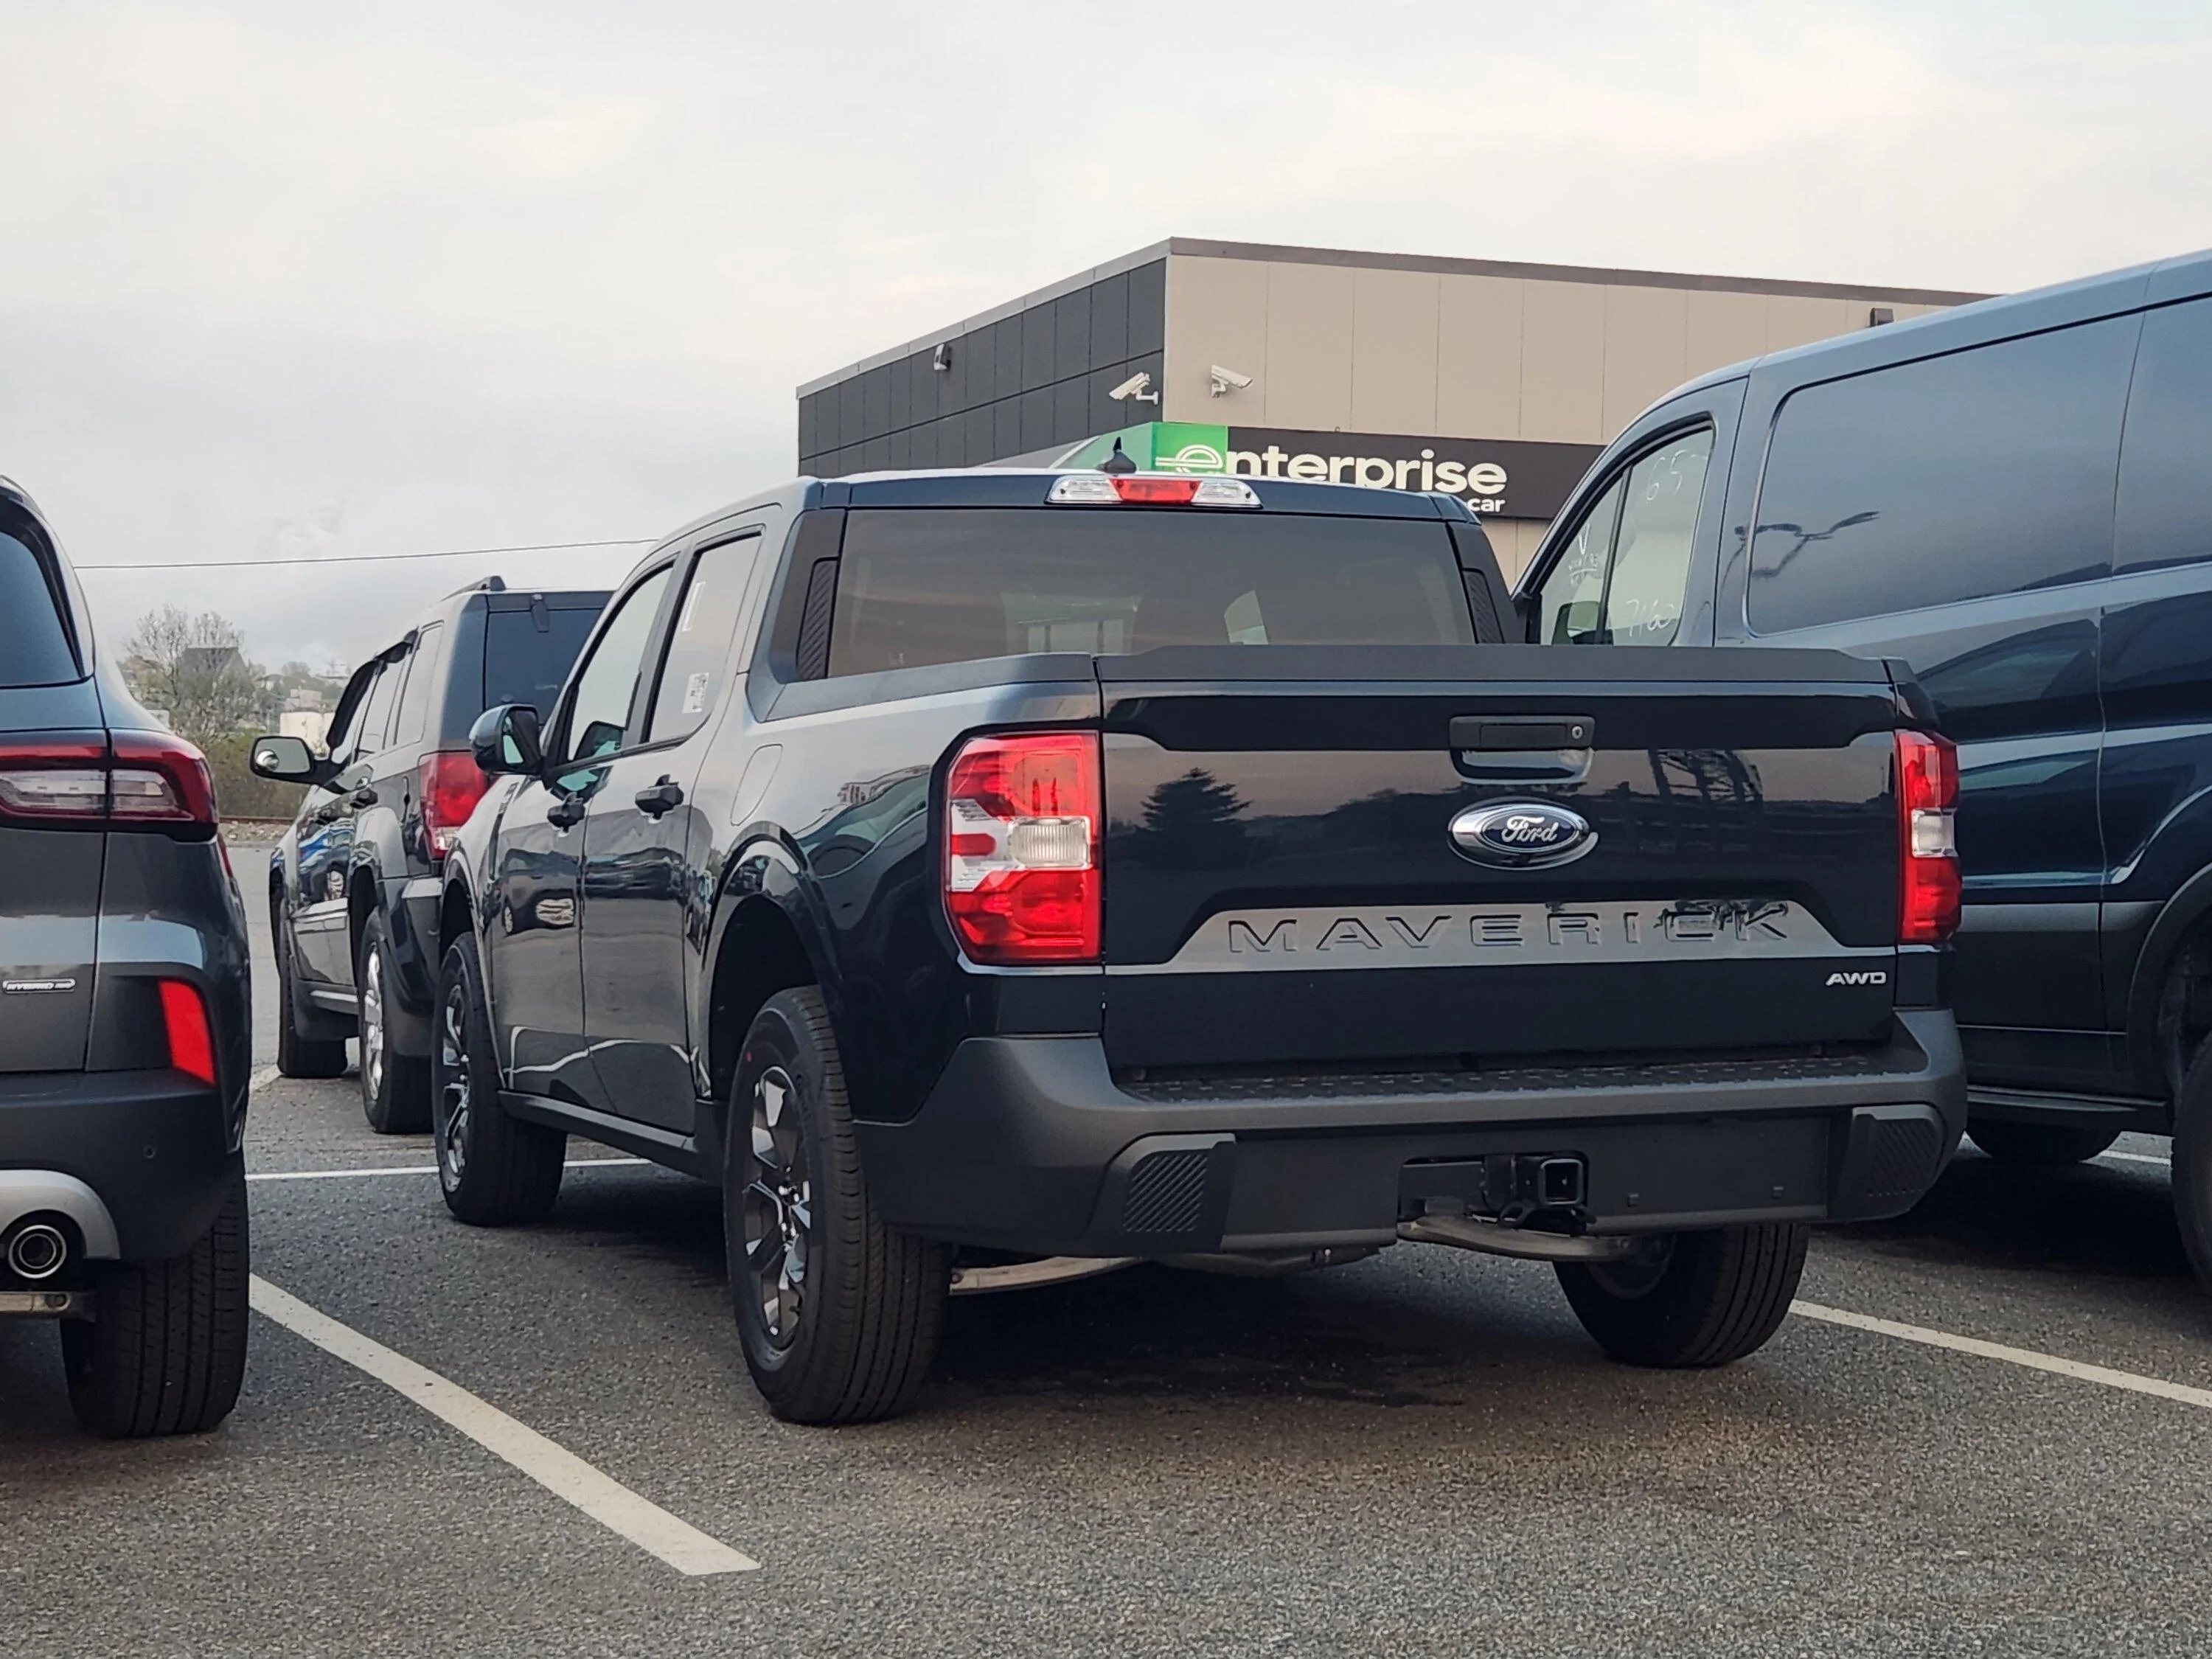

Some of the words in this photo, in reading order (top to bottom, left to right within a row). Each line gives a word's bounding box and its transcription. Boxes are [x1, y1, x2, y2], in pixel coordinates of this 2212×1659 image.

[1155, 444, 1507, 495] enterprise
[1501, 815, 1559, 842] Ford
[1228, 904, 1789, 953] MAVERICK
[1825, 971, 1887, 986] AWD
